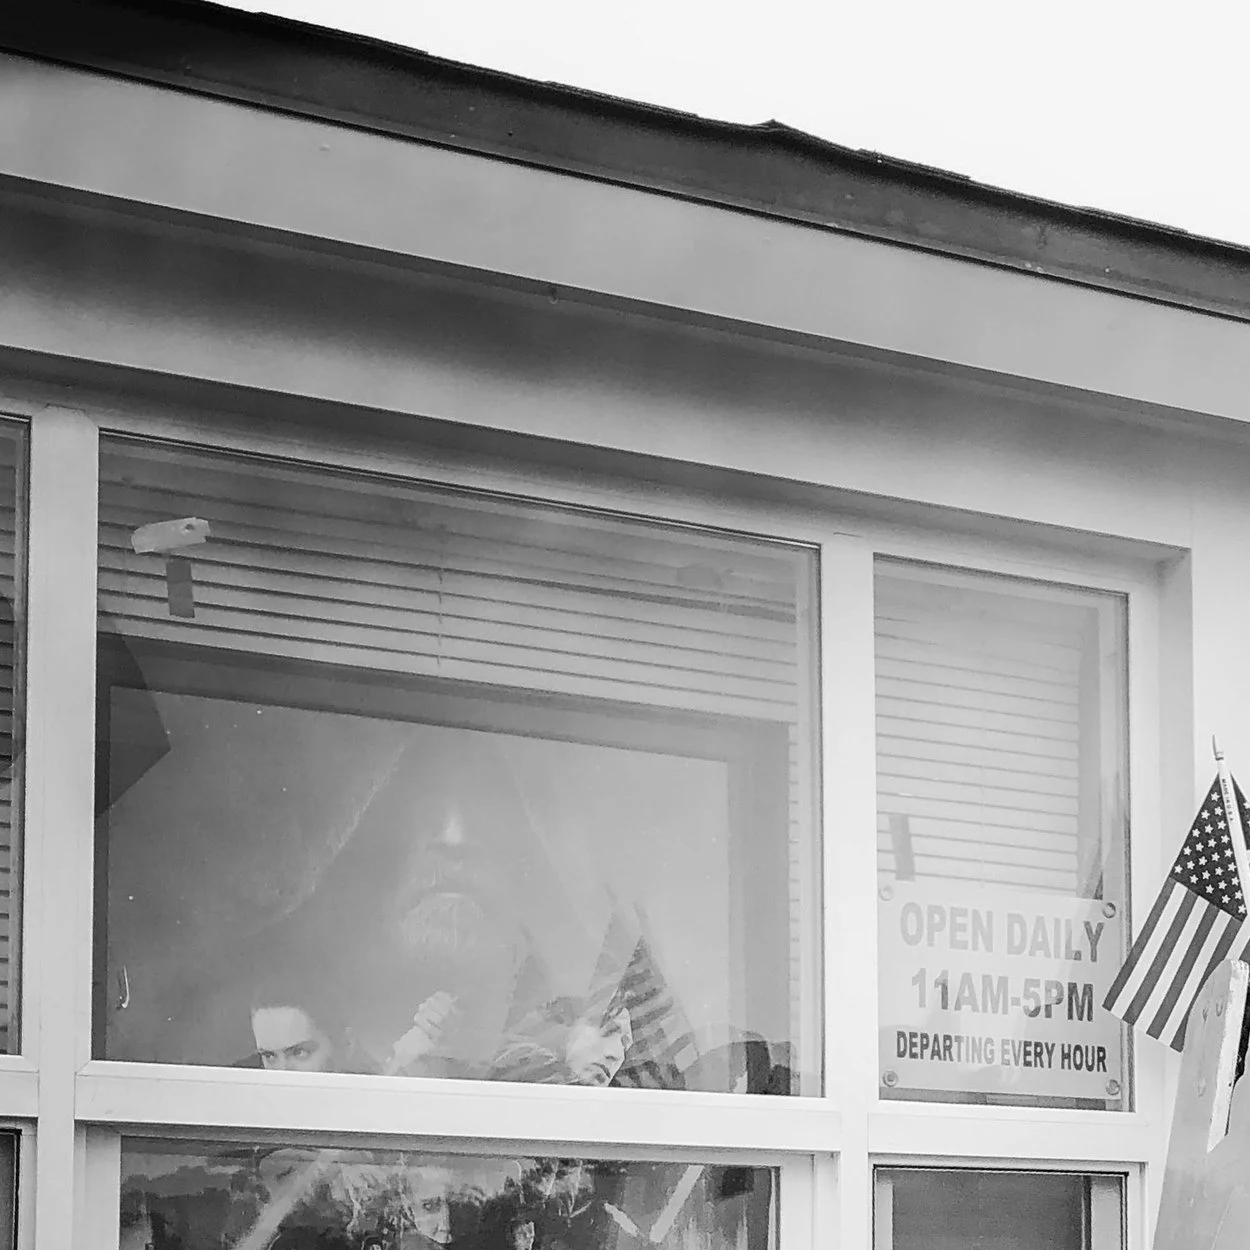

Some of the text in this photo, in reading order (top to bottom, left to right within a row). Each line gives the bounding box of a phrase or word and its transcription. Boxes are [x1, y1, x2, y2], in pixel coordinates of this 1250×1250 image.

[900, 901, 1105, 963] OPEN DAILY
[911, 967, 1095, 1023] 11AM-5PM
[896, 1030, 1108, 1073] DEPARTING EVERY HOUR
